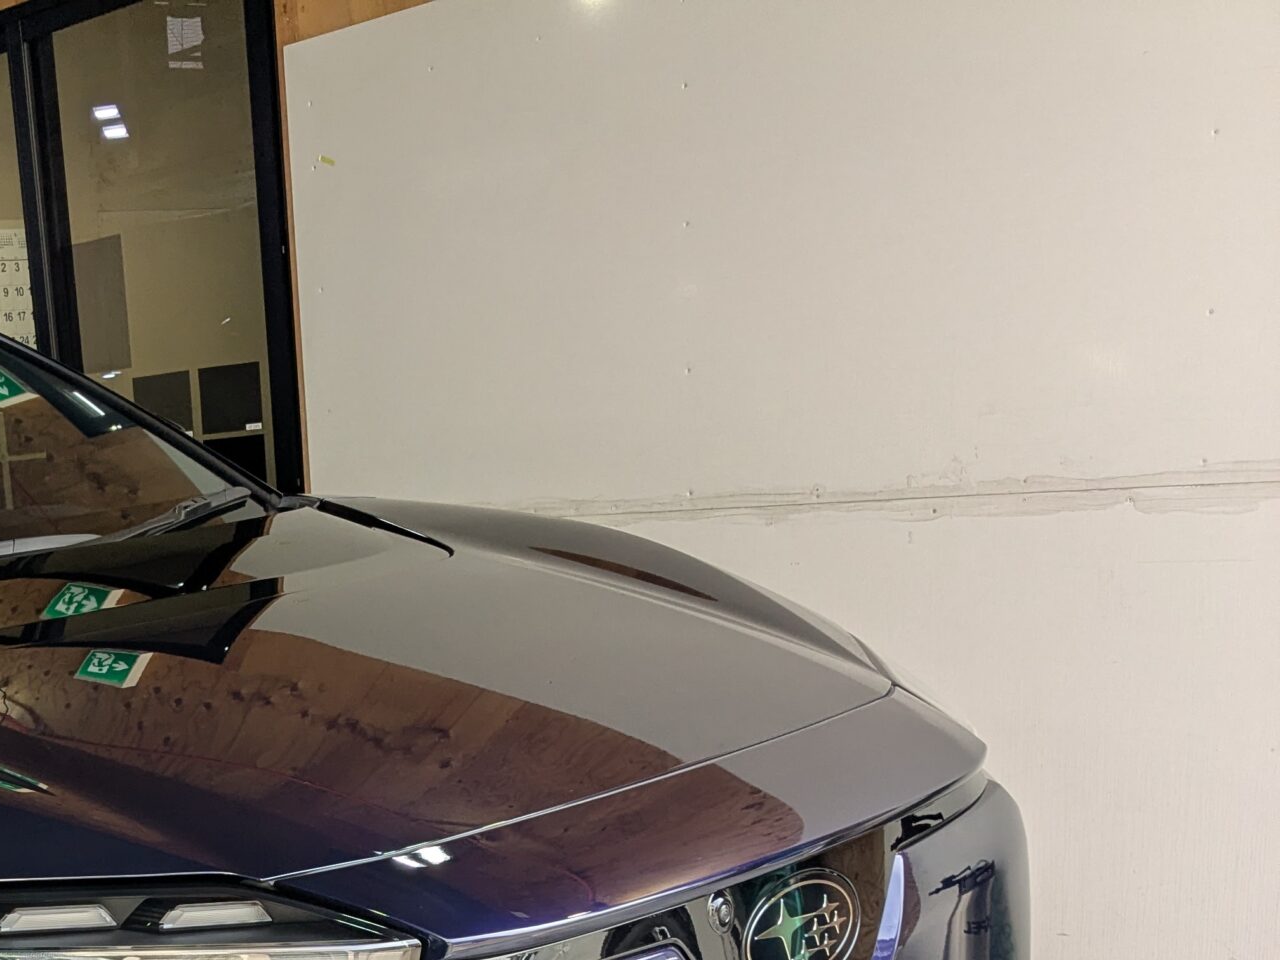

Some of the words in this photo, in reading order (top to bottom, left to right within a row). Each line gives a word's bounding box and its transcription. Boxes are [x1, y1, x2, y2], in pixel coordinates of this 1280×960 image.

[1, 263, 7, 272] 2
[15, 263, 20, 272] 3
[3, 288, 9, 297] 9
[15, 287, 24, 296] 10
[4, 313, 13, 322] 16
[17, 312, 25, 321] 17
